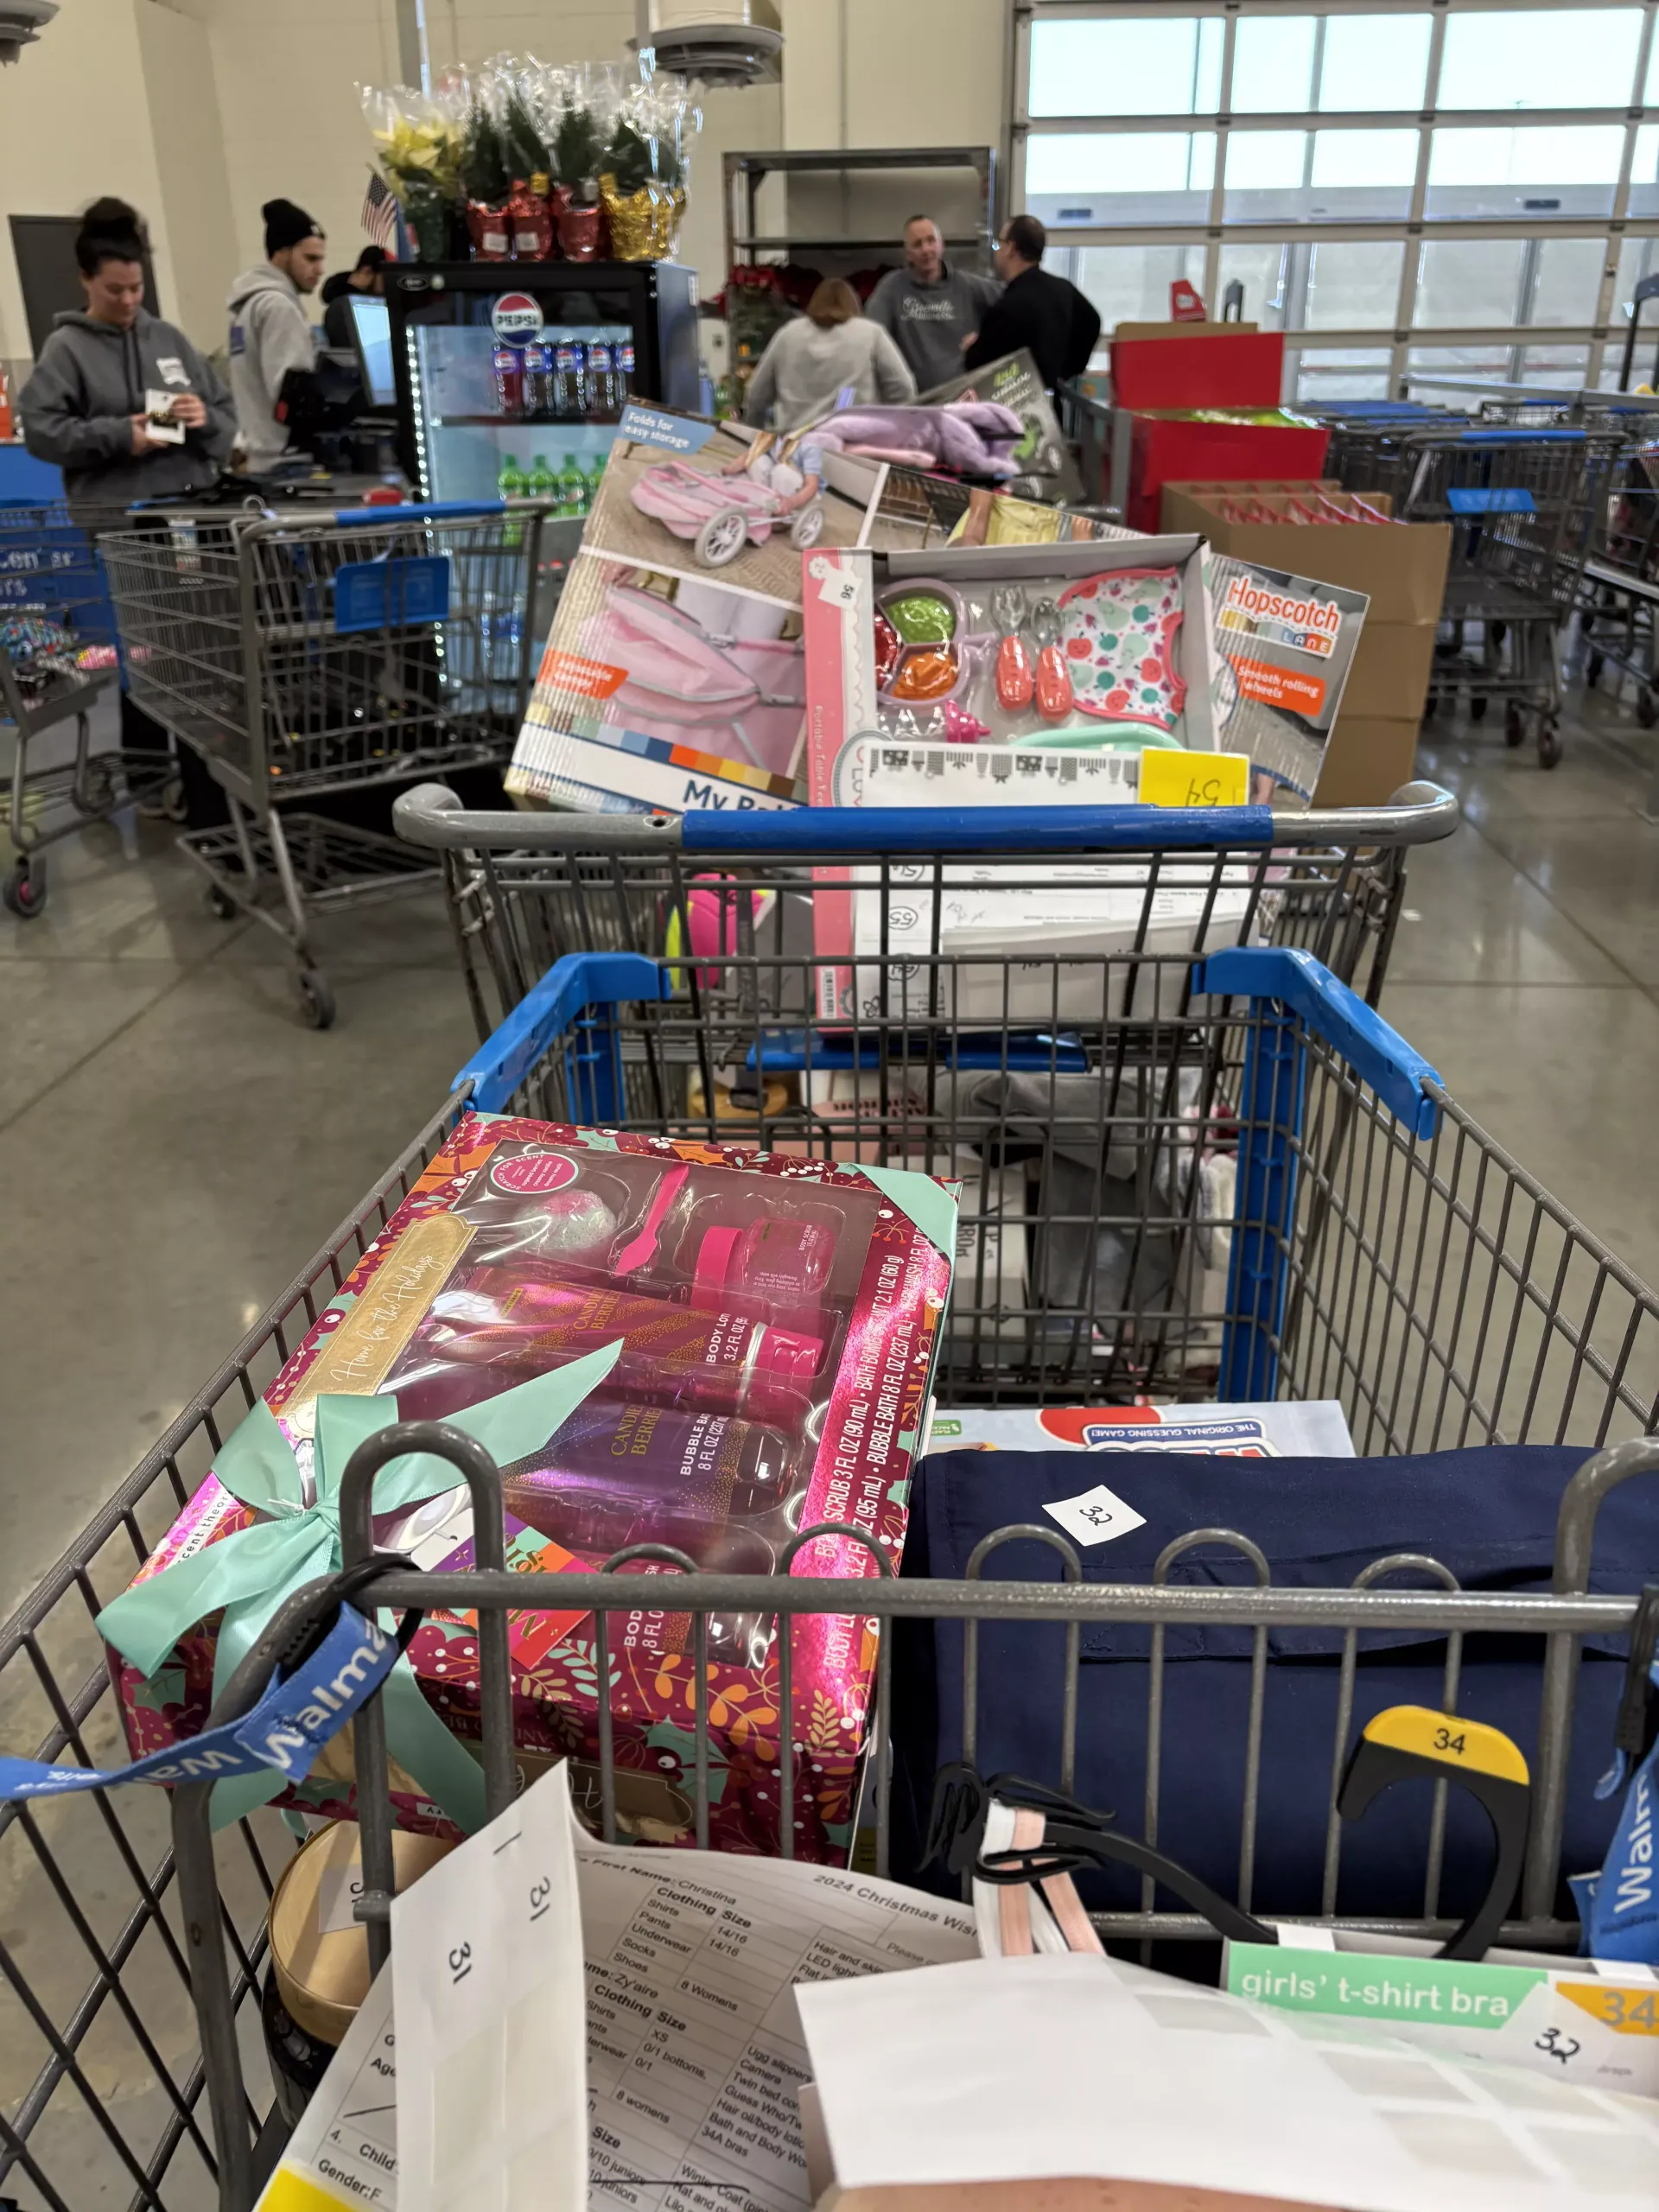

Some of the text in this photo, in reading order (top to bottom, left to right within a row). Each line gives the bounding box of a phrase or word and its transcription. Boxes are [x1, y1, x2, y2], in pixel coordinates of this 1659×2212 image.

[497, 314, 539, 327] PEPSI
[623, 424, 650, 440] easy
[1227, 577, 1340, 633] Hopscotch
[1237, 664, 1320, 699] Smooth rolling
[1243, 681, 1284, 700] wheels
[499, 1161, 514, 1172] FOR
[515, 1154, 545, 1163] SCENT
[880, 1264, 899, 1278] (60
[884, 1255, 905, 1265] g)
[382, 1255, 445, 1302] Holidays
[877, 1277, 896, 1289] OZ
[875, 1288, 893, 1306] 2.1
[370, 1300, 402, 1322] the
[897, 1319, 918, 1339] mL)
[706, 1328, 724, 1363] BODY
[723, 1323, 746, 1361] 3.2 FL OZ
[889, 1336, 910, 1358] (237
[329, 1343, 374, 1382] Home
[885, 1357, 906, 1372] OZ
[854, 1363, 877, 1390] BATH
[881, 1383, 900, 1395] 8
[882, 1373, 904, 1384] FL
[849, 1399, 871, 1421] mL)
[875, 1393, 899, 1422] BATH
[703, 1434, 720, 1447] OZ
[842, 1419, 865, 1438] (90
[1091, 1422, 1256, 1438] THE ORIGINAL GUESSING GAME!
[679, 1425, 705, 1476] BUBBLE
[699, 1449, 715, 1461] FL
[838, 1437, 861, 1454] OZ
[866, 1421, 894, 1465] BUBBLE
[697, 1462, 712, 1471] 8
[833, 1469, 853, 1480] 3
[835, 1456, 857, 1469] FL
[861, 1475, 887, 1499] mL)
[823, 1481, 851, 1522] SCRUB
[855, 1498, 878, 1519] (95
[177, 1491, 230, 1563] cent theor
[1079, 1505, 1113, 1527] 32
[623, 1610, 643, 1648] BOD
[641, 1622, 662, 1649] 8 FL
[1433, 1727, 1467, 1756] 34
[592, 1859, 627, 1871] First
[677, 1879, 737, 1906] Christina
[656, 1886, 752, 1929] Clothing Size
[813, 1874, 854, 1892] 2024
[856, 1887, 939, 1922] Christmas
[638, 1910, 741, 1958] Pants 14/16
[647, 1898, 749, 1945] Shirts 14/16
[621, 1936, 657, 1960] Socks
[631, 1923, 693, 1955] Underwear
[613, 1952, 649, 1974] Shoes
[805, 1952, 831, 1968] LED
[813, 1941, 861, 1966] Hair and
[886, 1942, 925, 1963] Please
[614, 1973, 659, 1999] Zy'aire
[680, 1980, 740, 2012] 8 Womens
[1337, 1976, 1443, 2010] t-shirt
[1451, 1986, 1510, 2016] bra
[586, 1999, 617, 2021] Shirts
[594, 1984, 687, 2032] Clothing Size
[1601, 1992, 1659, 2029] 34
[652, 2029, 670, 2044] XS
[1534, 2027, 1582, 2064] 32
[634, 2056, 653, 2072] 0/1
[642, 2042, 708, 2080] 0/1 bottoms,
[740, 2059, 783, 2085] Camera
[747, 2045, 814, 2084] Ugg slippers
[724, 2084, 760, 2108] Guess
[733, 2070, 782, 2101] Twin bed
[615, 2089, 671, 2125] 8 womens
[715, 2097, 784, 2139] Hair oil/body
[330, 2128, 342, 2145] 4.
[591, 2126, 622, 2151] Size
[701, 2125, 750, 2158] 34A bras
[709, 2111, 786, 2160] Bath and Body
[601, 2178, 639, 2204] juniors
[692, 2191, 715, 2209] and
[716, 2183, 747, 2207] Coat
